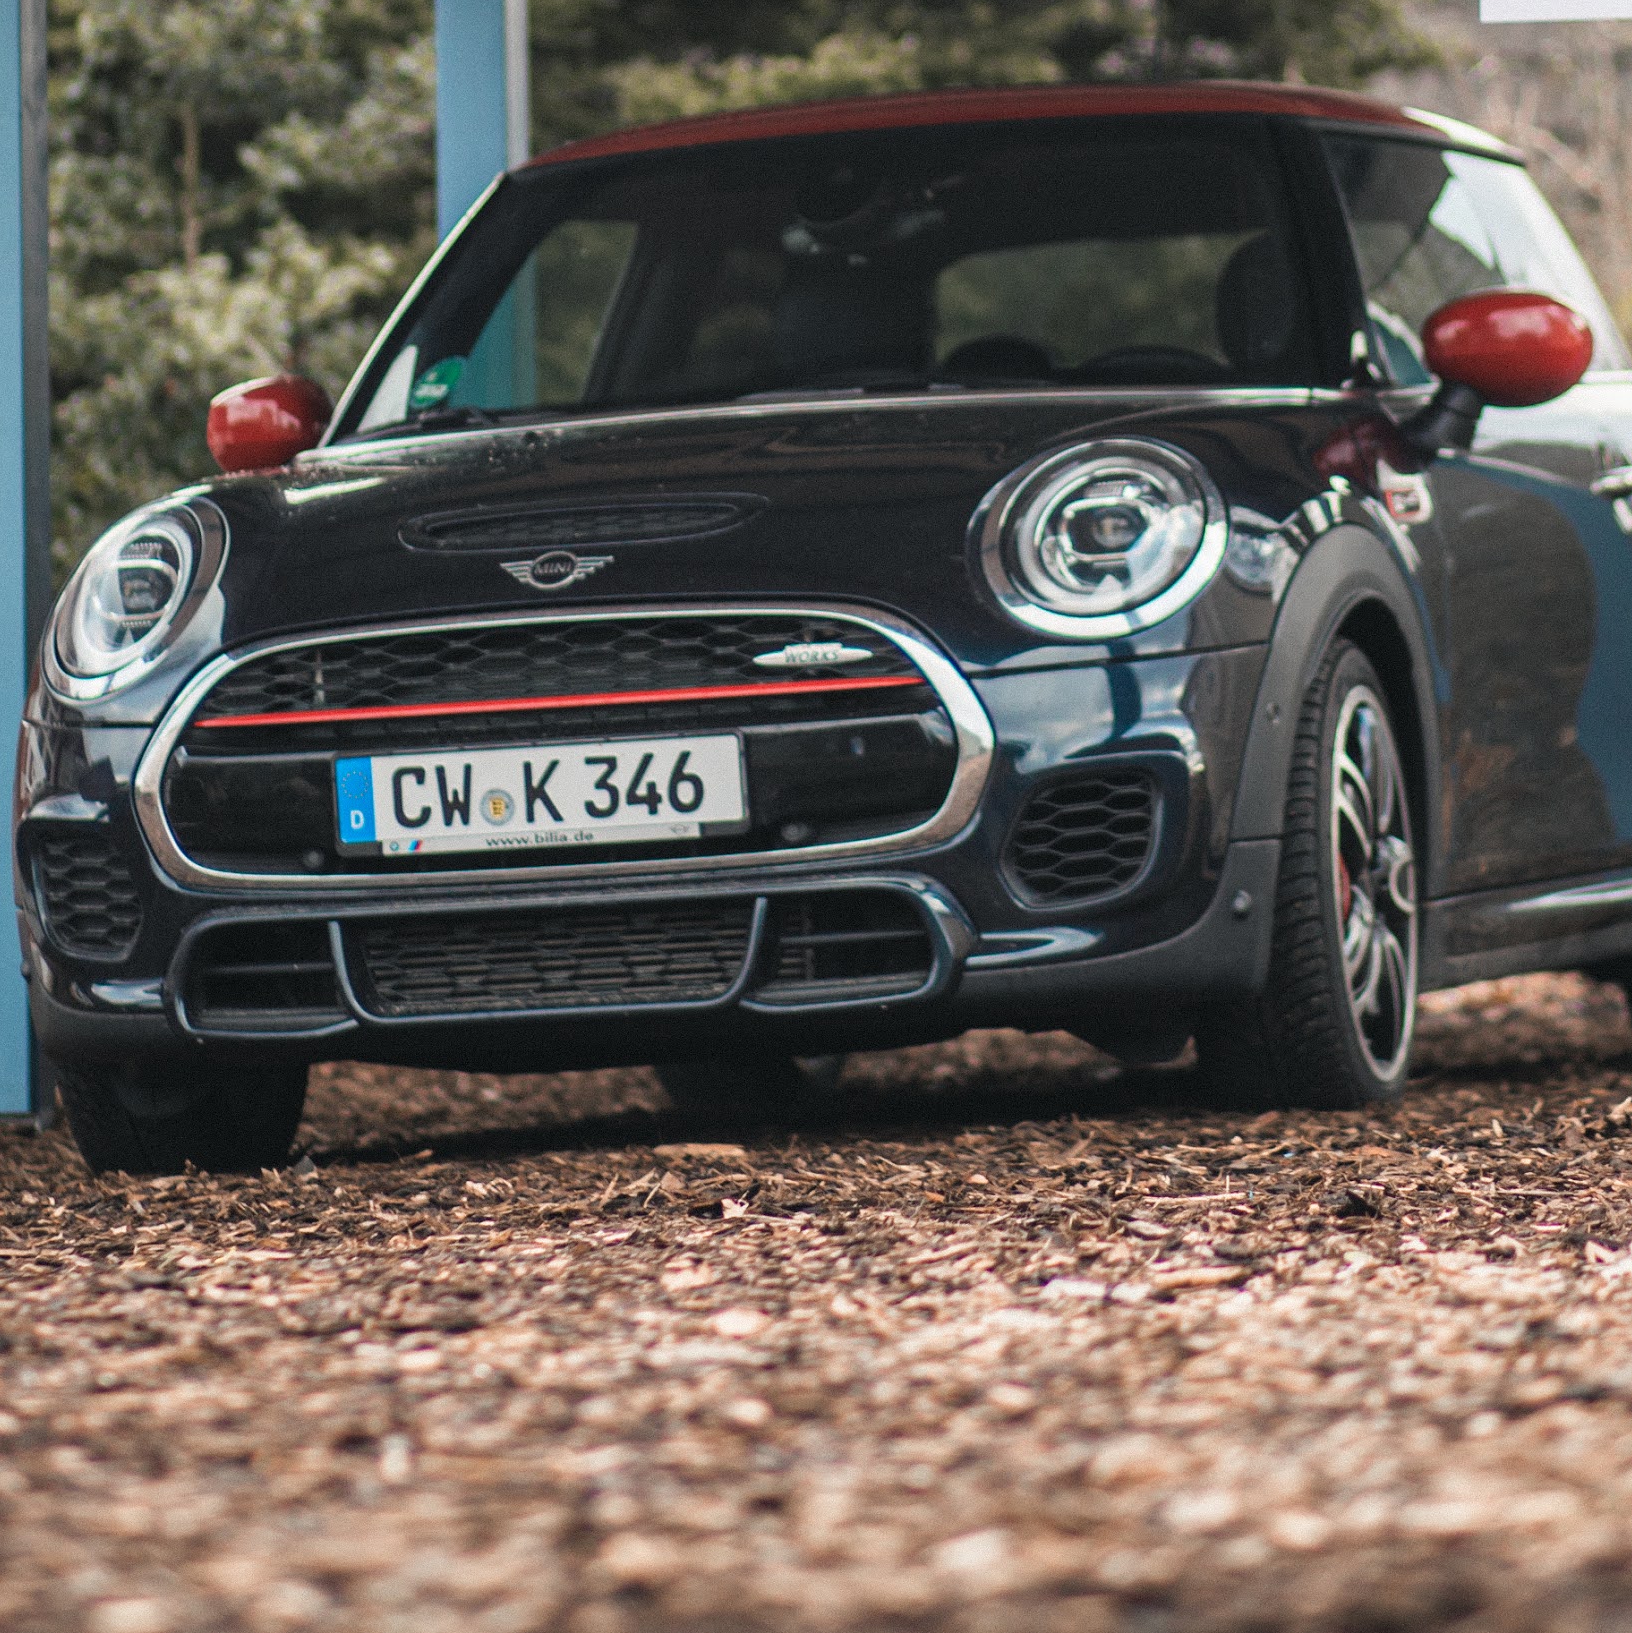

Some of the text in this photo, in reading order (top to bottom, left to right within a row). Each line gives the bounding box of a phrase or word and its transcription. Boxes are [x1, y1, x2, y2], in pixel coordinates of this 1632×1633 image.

[533, 561, 572, 575] MINI
[783, 650, 840, 664] WORKS
[391, 763, 473, 829] CW
[349, 809, 365, 831] D
[484, 830, 595, 849] www.bilia.de
